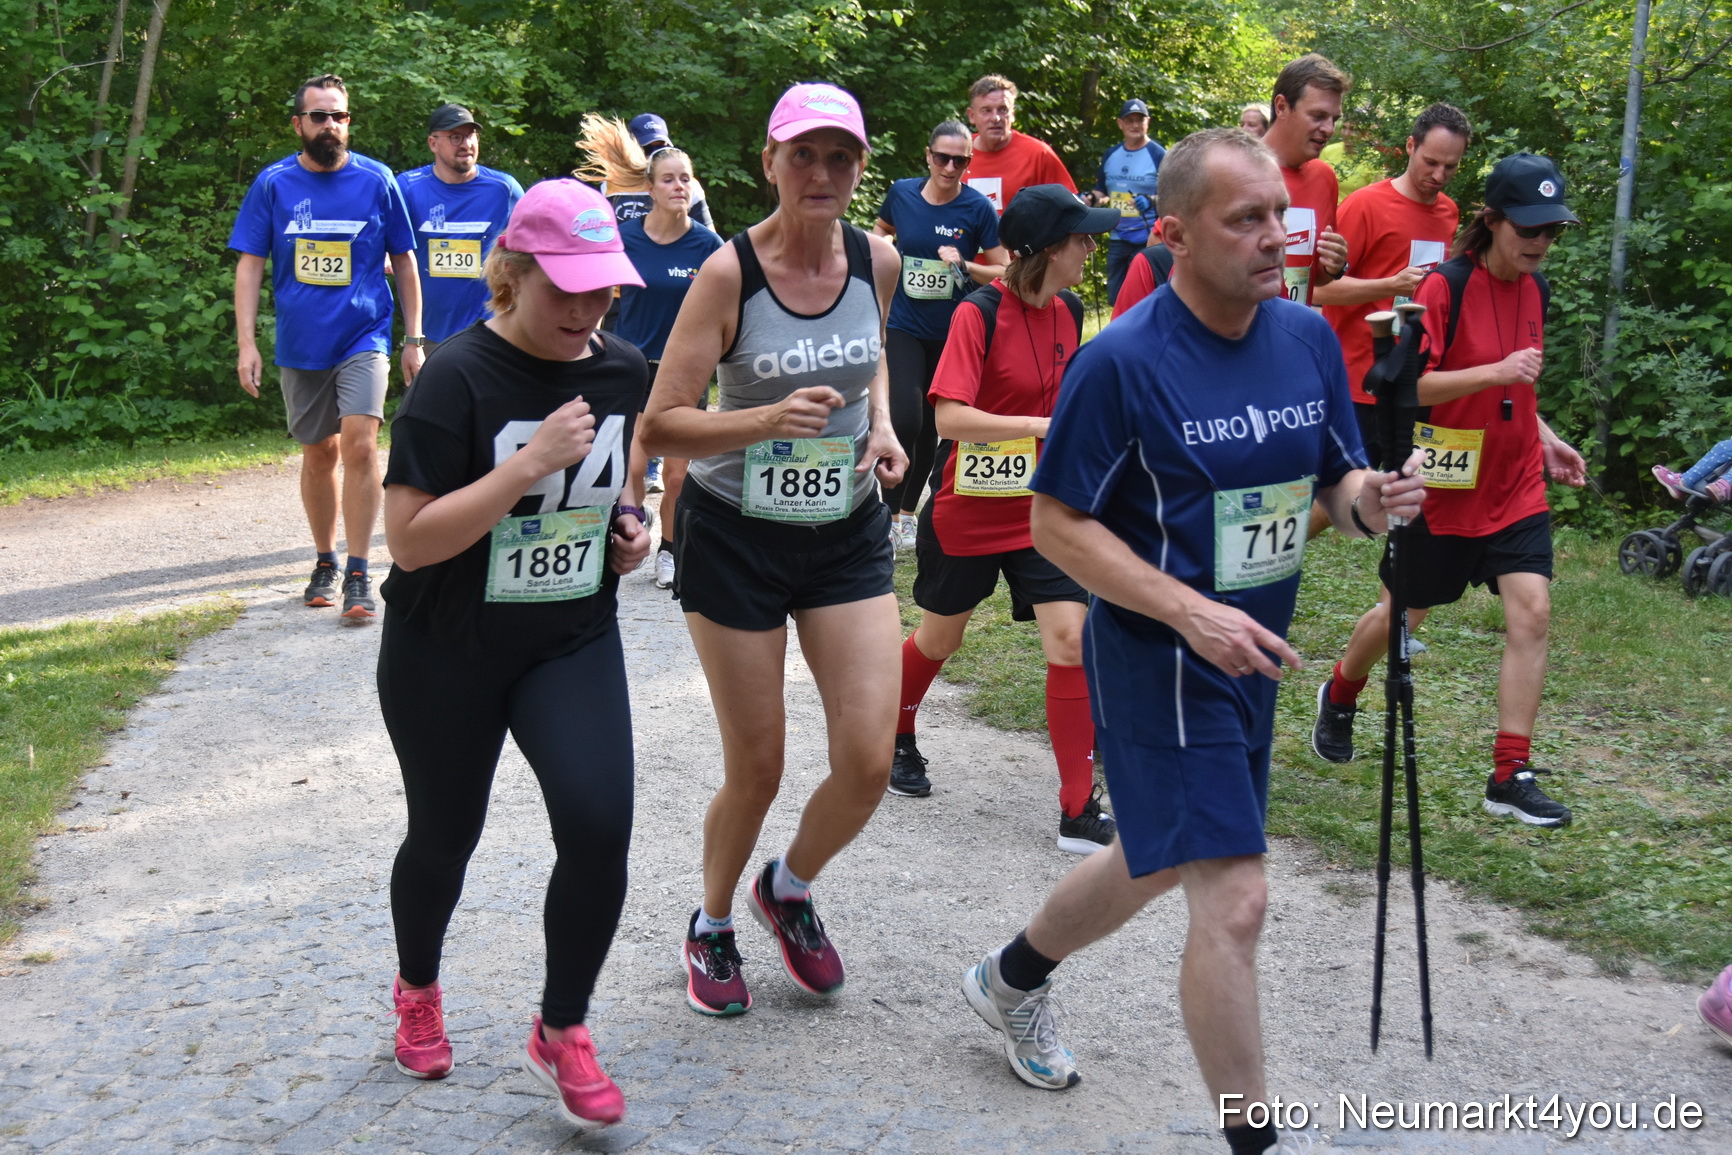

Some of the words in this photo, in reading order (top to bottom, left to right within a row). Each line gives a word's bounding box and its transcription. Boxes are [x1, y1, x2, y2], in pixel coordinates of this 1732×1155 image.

[935, 225, 953, 237] vhs
[301, 255, 343, 273] 2132
[435, 253, 473, 267] 2130
[668, 267, 688, 278] vhs
[907, 271, 947, 289] 2395
[753, 334, 881, 379] adidas
[1056, 343, 1064, 359] 9
[1182, 416, 1248, 445] EURO
[1267, 400, 1325, 432] POLES
[964, 454, 1027, 478] 2349
[1418, 469, 1434, 477] Lang
[1437, 471, 1453, 480] Tanja
[760, 467, 841, 498] 1885
[773, 498, 803, 507] Lanzer
[805, 499, 827, 507] Karin
[1242, 516, 1297, 559] 712
[507, 540, 592, 579] 1887
[526, 579, 550, 588] Sand
[553, 577, 574, 586] Lena
